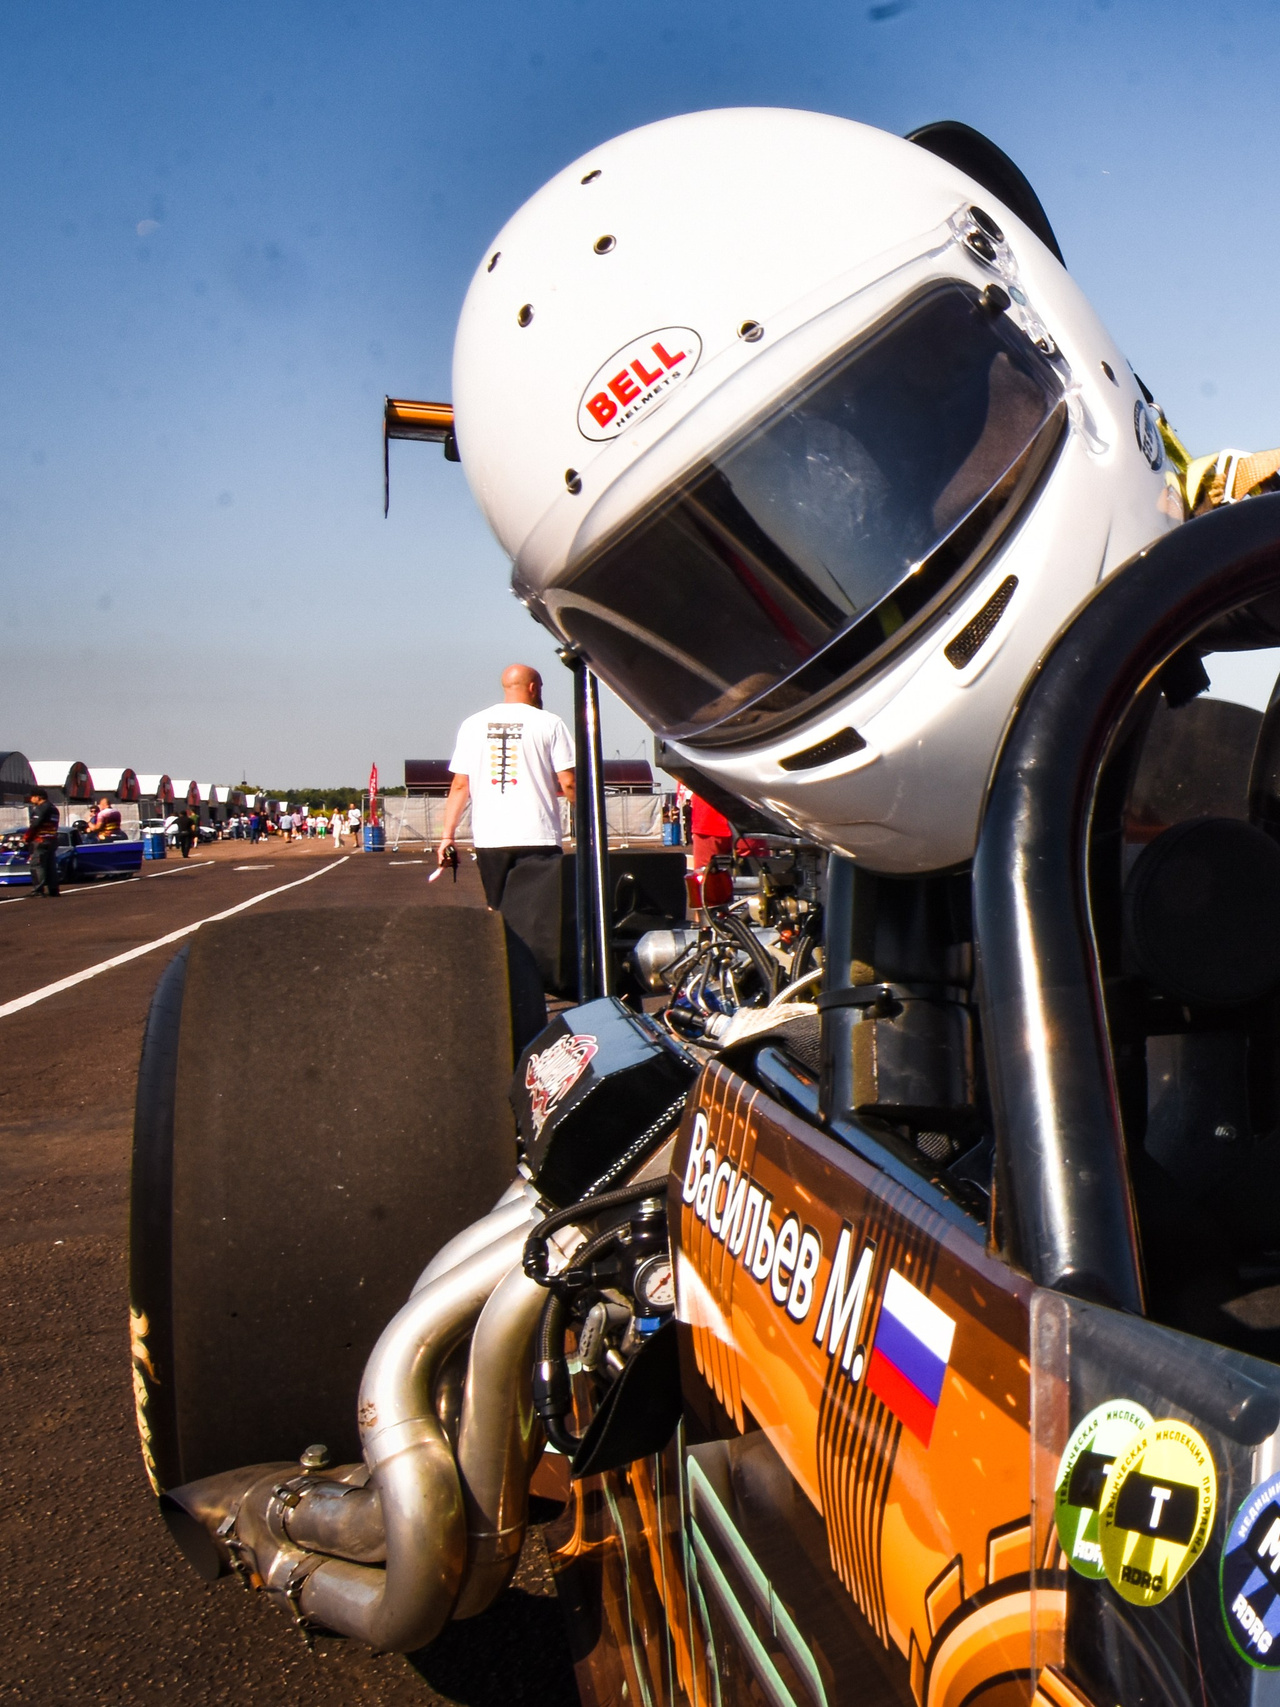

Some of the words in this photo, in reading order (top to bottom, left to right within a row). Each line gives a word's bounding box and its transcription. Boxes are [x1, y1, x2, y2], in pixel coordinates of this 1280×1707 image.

[585, 342, 687, 429] BELL
[616, 371, 681, 428] HELMETS
[682, 1111, 822, 1321] Васильев
[815, 1227, 876, 1383] М.
[1106, 1411, 1146, 1431] ИНСПЕКЦ
[1105, 1438, 1148, 1528] ТЕХНИЧЕСКАЯ
[1156, 1430, 1206, 1466] ИНСПЕКЦИЯ
[1150, 1486, 1172, 1529] Т
